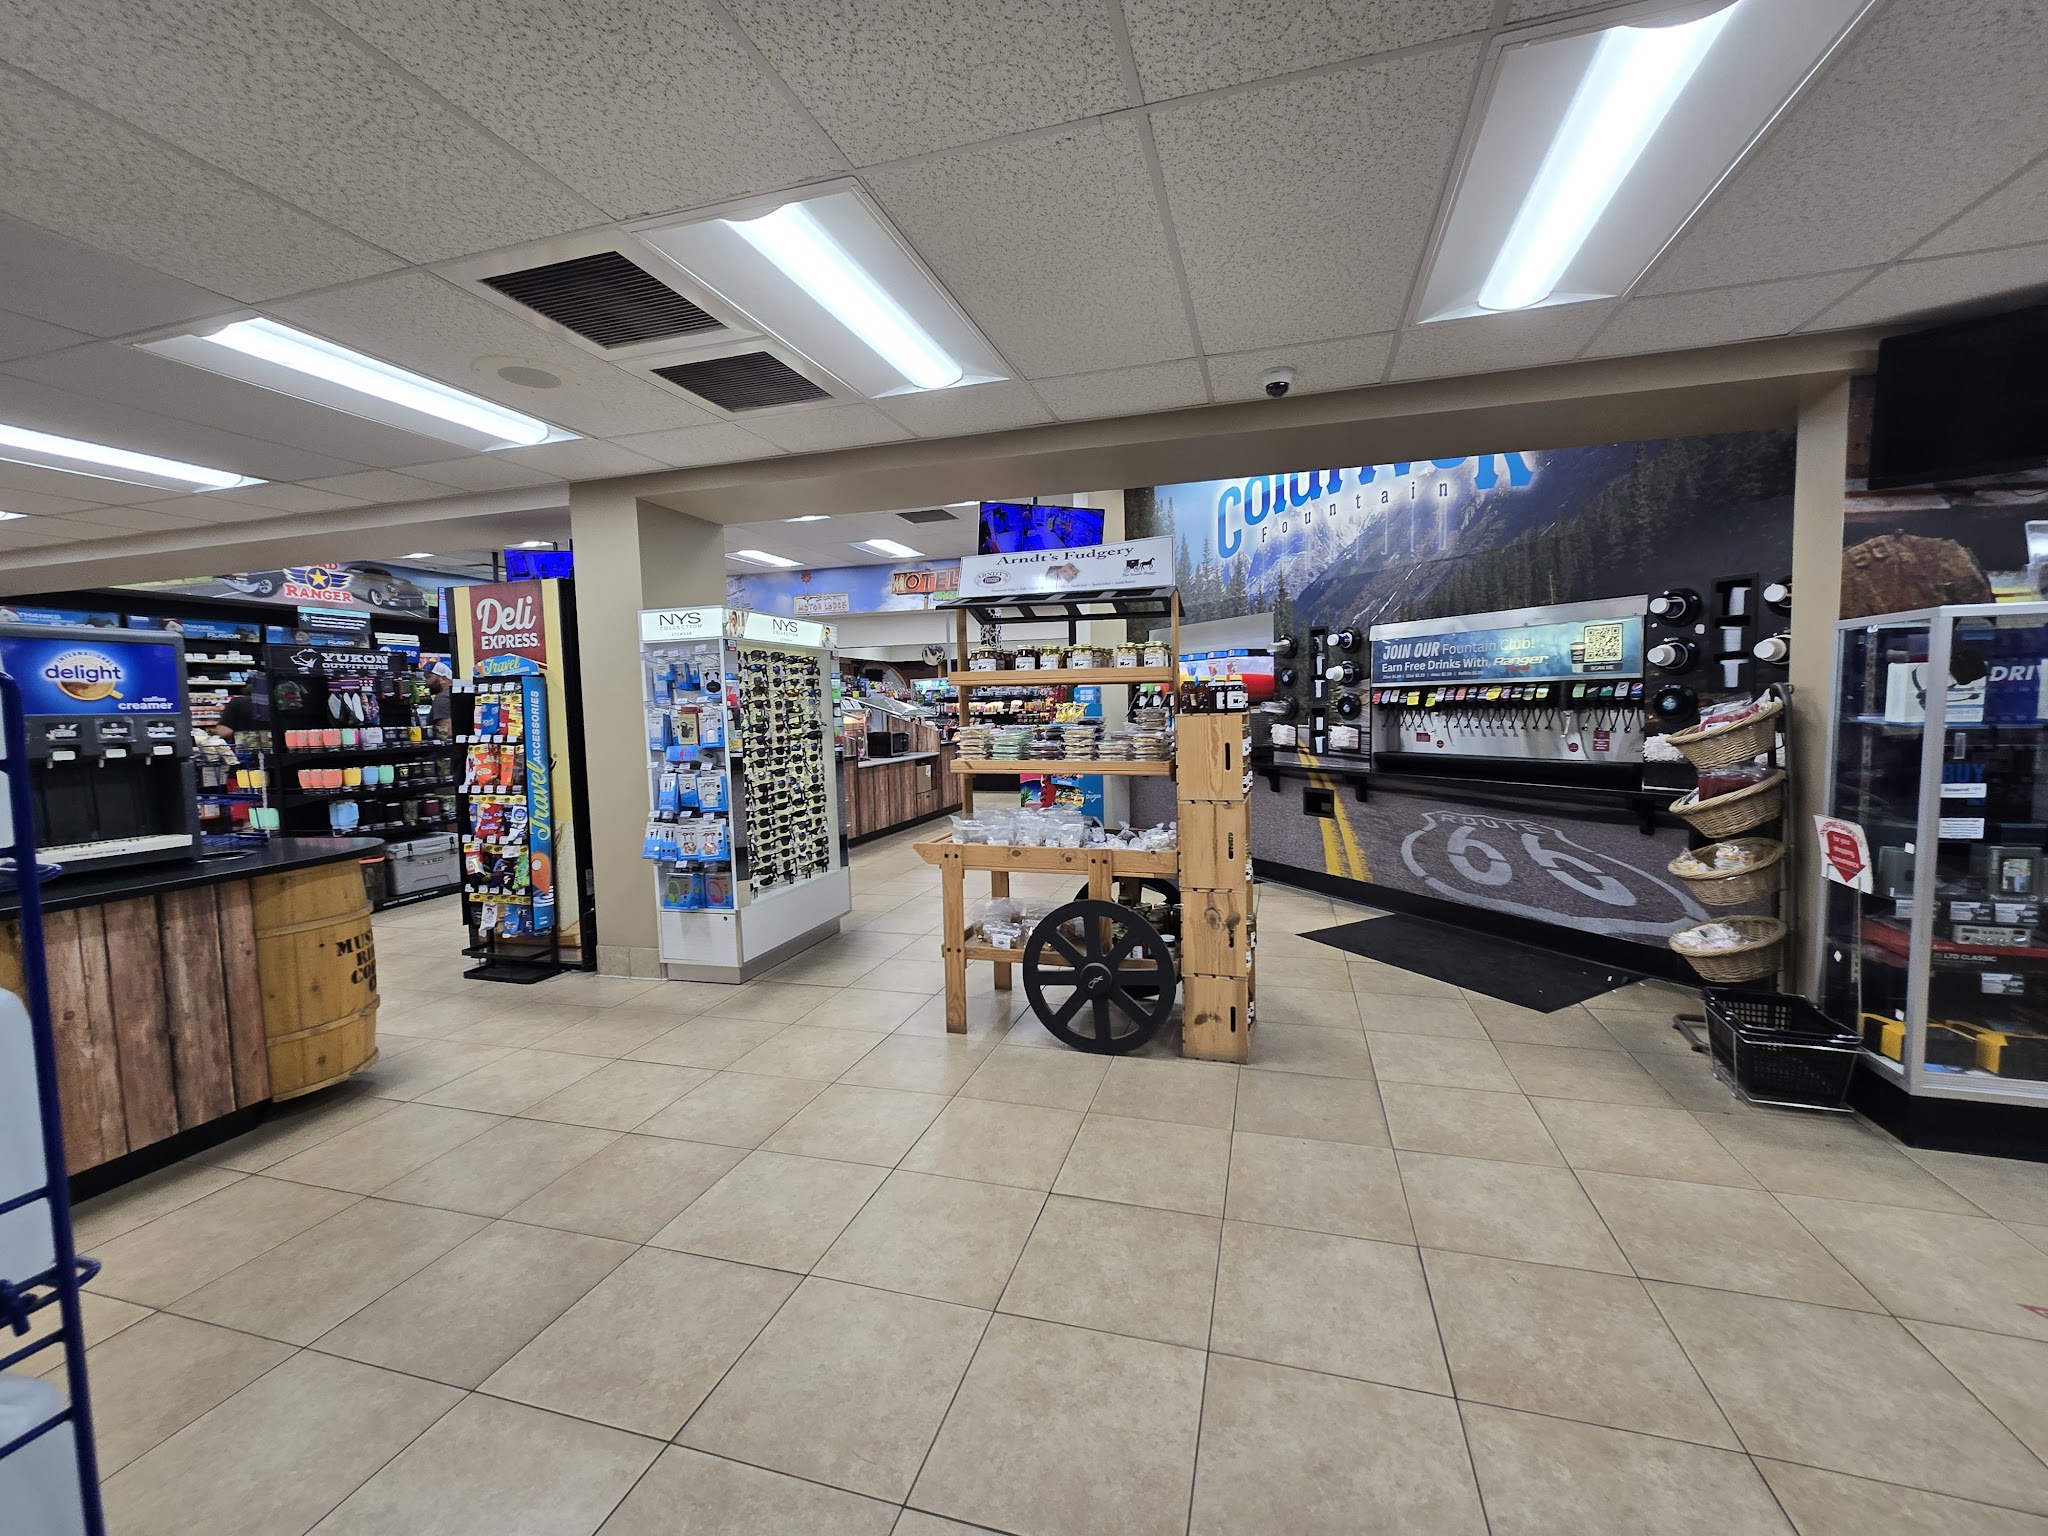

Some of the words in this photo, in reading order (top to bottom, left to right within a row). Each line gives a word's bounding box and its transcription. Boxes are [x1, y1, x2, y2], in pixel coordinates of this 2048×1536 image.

[1262, 480, 1449, 543] Fountain
[996, 552, 1059, 566] Arndt's
[1064, 546, 1136, 561] Fudgery
[892, 571, 960, 593] MOTEL
[285, 583, 352, 602] RANGER
[476, 595, 537, 635] Deli
[659, 612, 702, 626] NYS
[772, 618, 798, 633] NYS
[206, 632, 241, 641] FLAVOR
[321, 652, 389, 665] YUKON
[1382, 643, 1412, 661] JOIN
[1413, 641, 1440, 658] OUR
[1442, 640, 1497, 656] Fountain
[1500, 637, 1537, 651] Club!
[45, 664, 122, 683] delight
[321, 662, 389, 671] OUTFITTERS
[484, 656, 520, 676] Travel
[1382, 663, 1403, 673] Earn
[1404, 661, 1426, 672] Free
[1428, 658, 1461, 671] Drinks
[1463, 656, 1489, 669] With
[1493, 655, 1549, 667] Ranger
[117, 701, 174, 711] creamer
[530, 690, 541, 764] ACCESSORIES
[527, 760, 552, 842] Travel
[1440, 813, 1546, 835] ROUTE
[1446, 826, 1638, 907] 66
